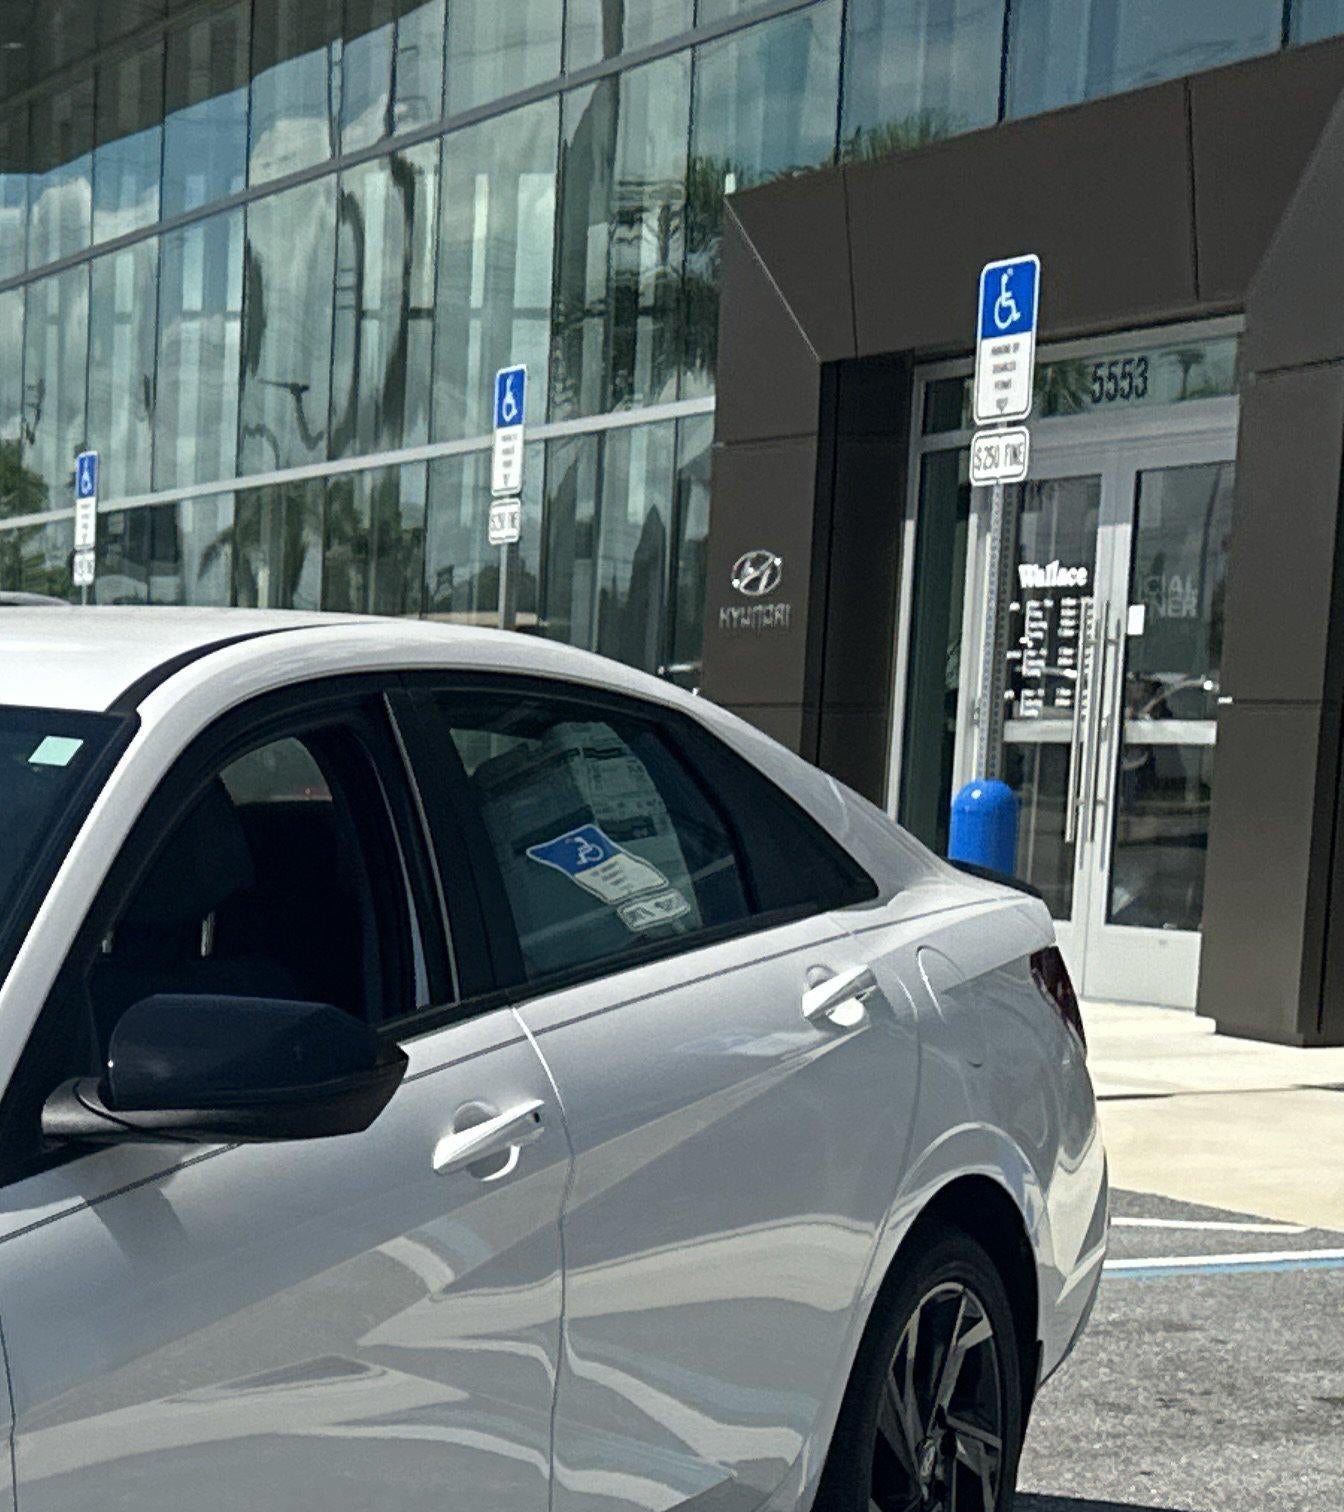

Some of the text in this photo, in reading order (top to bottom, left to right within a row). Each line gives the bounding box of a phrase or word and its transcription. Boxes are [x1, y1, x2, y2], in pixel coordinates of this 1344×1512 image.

[1090, 355, 1149, 404] 5553
[1018, 559, 1088, 588] Wallace
[719, 603, 791, 628] HYUNDAI
